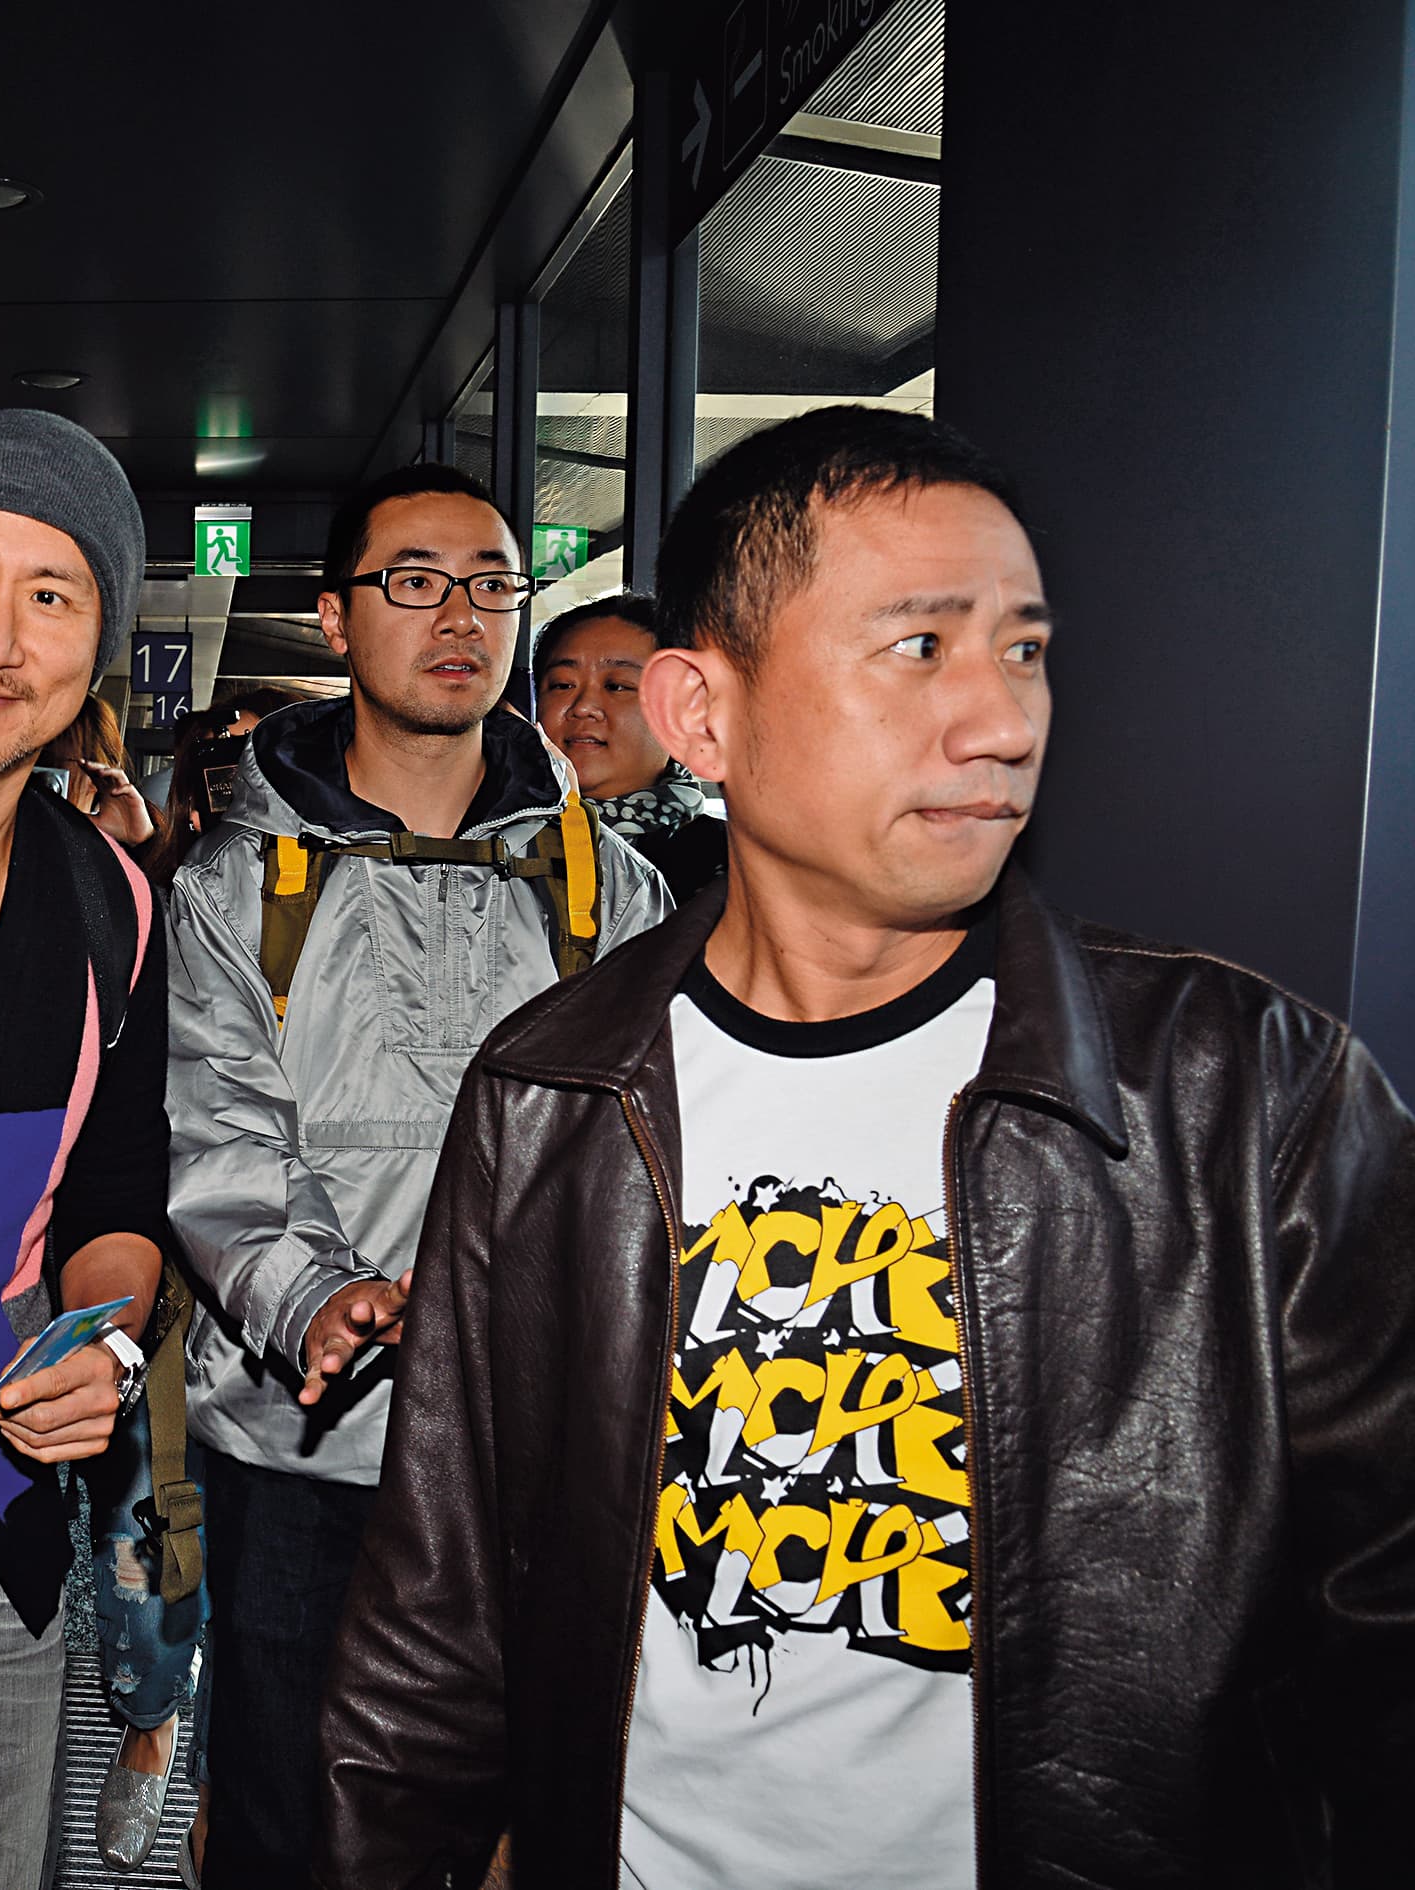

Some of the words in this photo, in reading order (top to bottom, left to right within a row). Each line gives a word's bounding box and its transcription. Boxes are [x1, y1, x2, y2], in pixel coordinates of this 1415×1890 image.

[779, 0, 876, 105] Smoking
[136, 644, 188, 683] 17
[156, 696, 189, 720] 16
